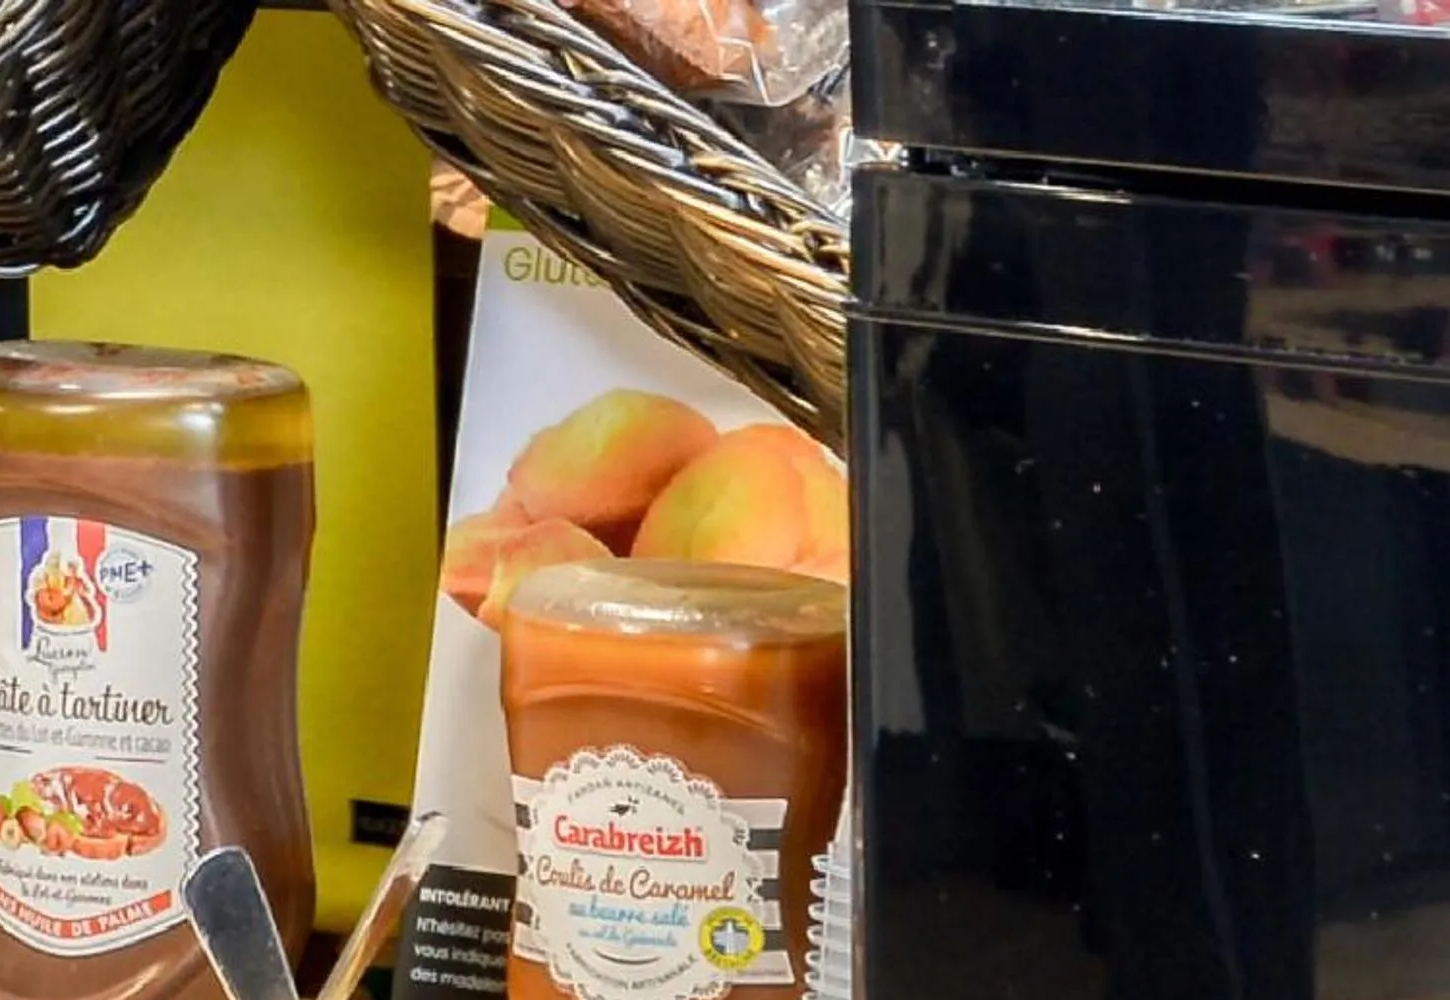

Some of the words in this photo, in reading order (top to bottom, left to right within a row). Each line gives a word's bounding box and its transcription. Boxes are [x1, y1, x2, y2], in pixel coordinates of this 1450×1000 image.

[37, 682, 58, 717] à
[60, 682, 175, 726] tartiner
[554, 815, 705, 858] Carabreizh
[536, 855, 596, 892] Coulis
[598, 865, 626, 895] de
[629, 868, 735, 901] Caramel
[71, 921, 92, 937] DE
[99, 901, 153, 931] PALME
